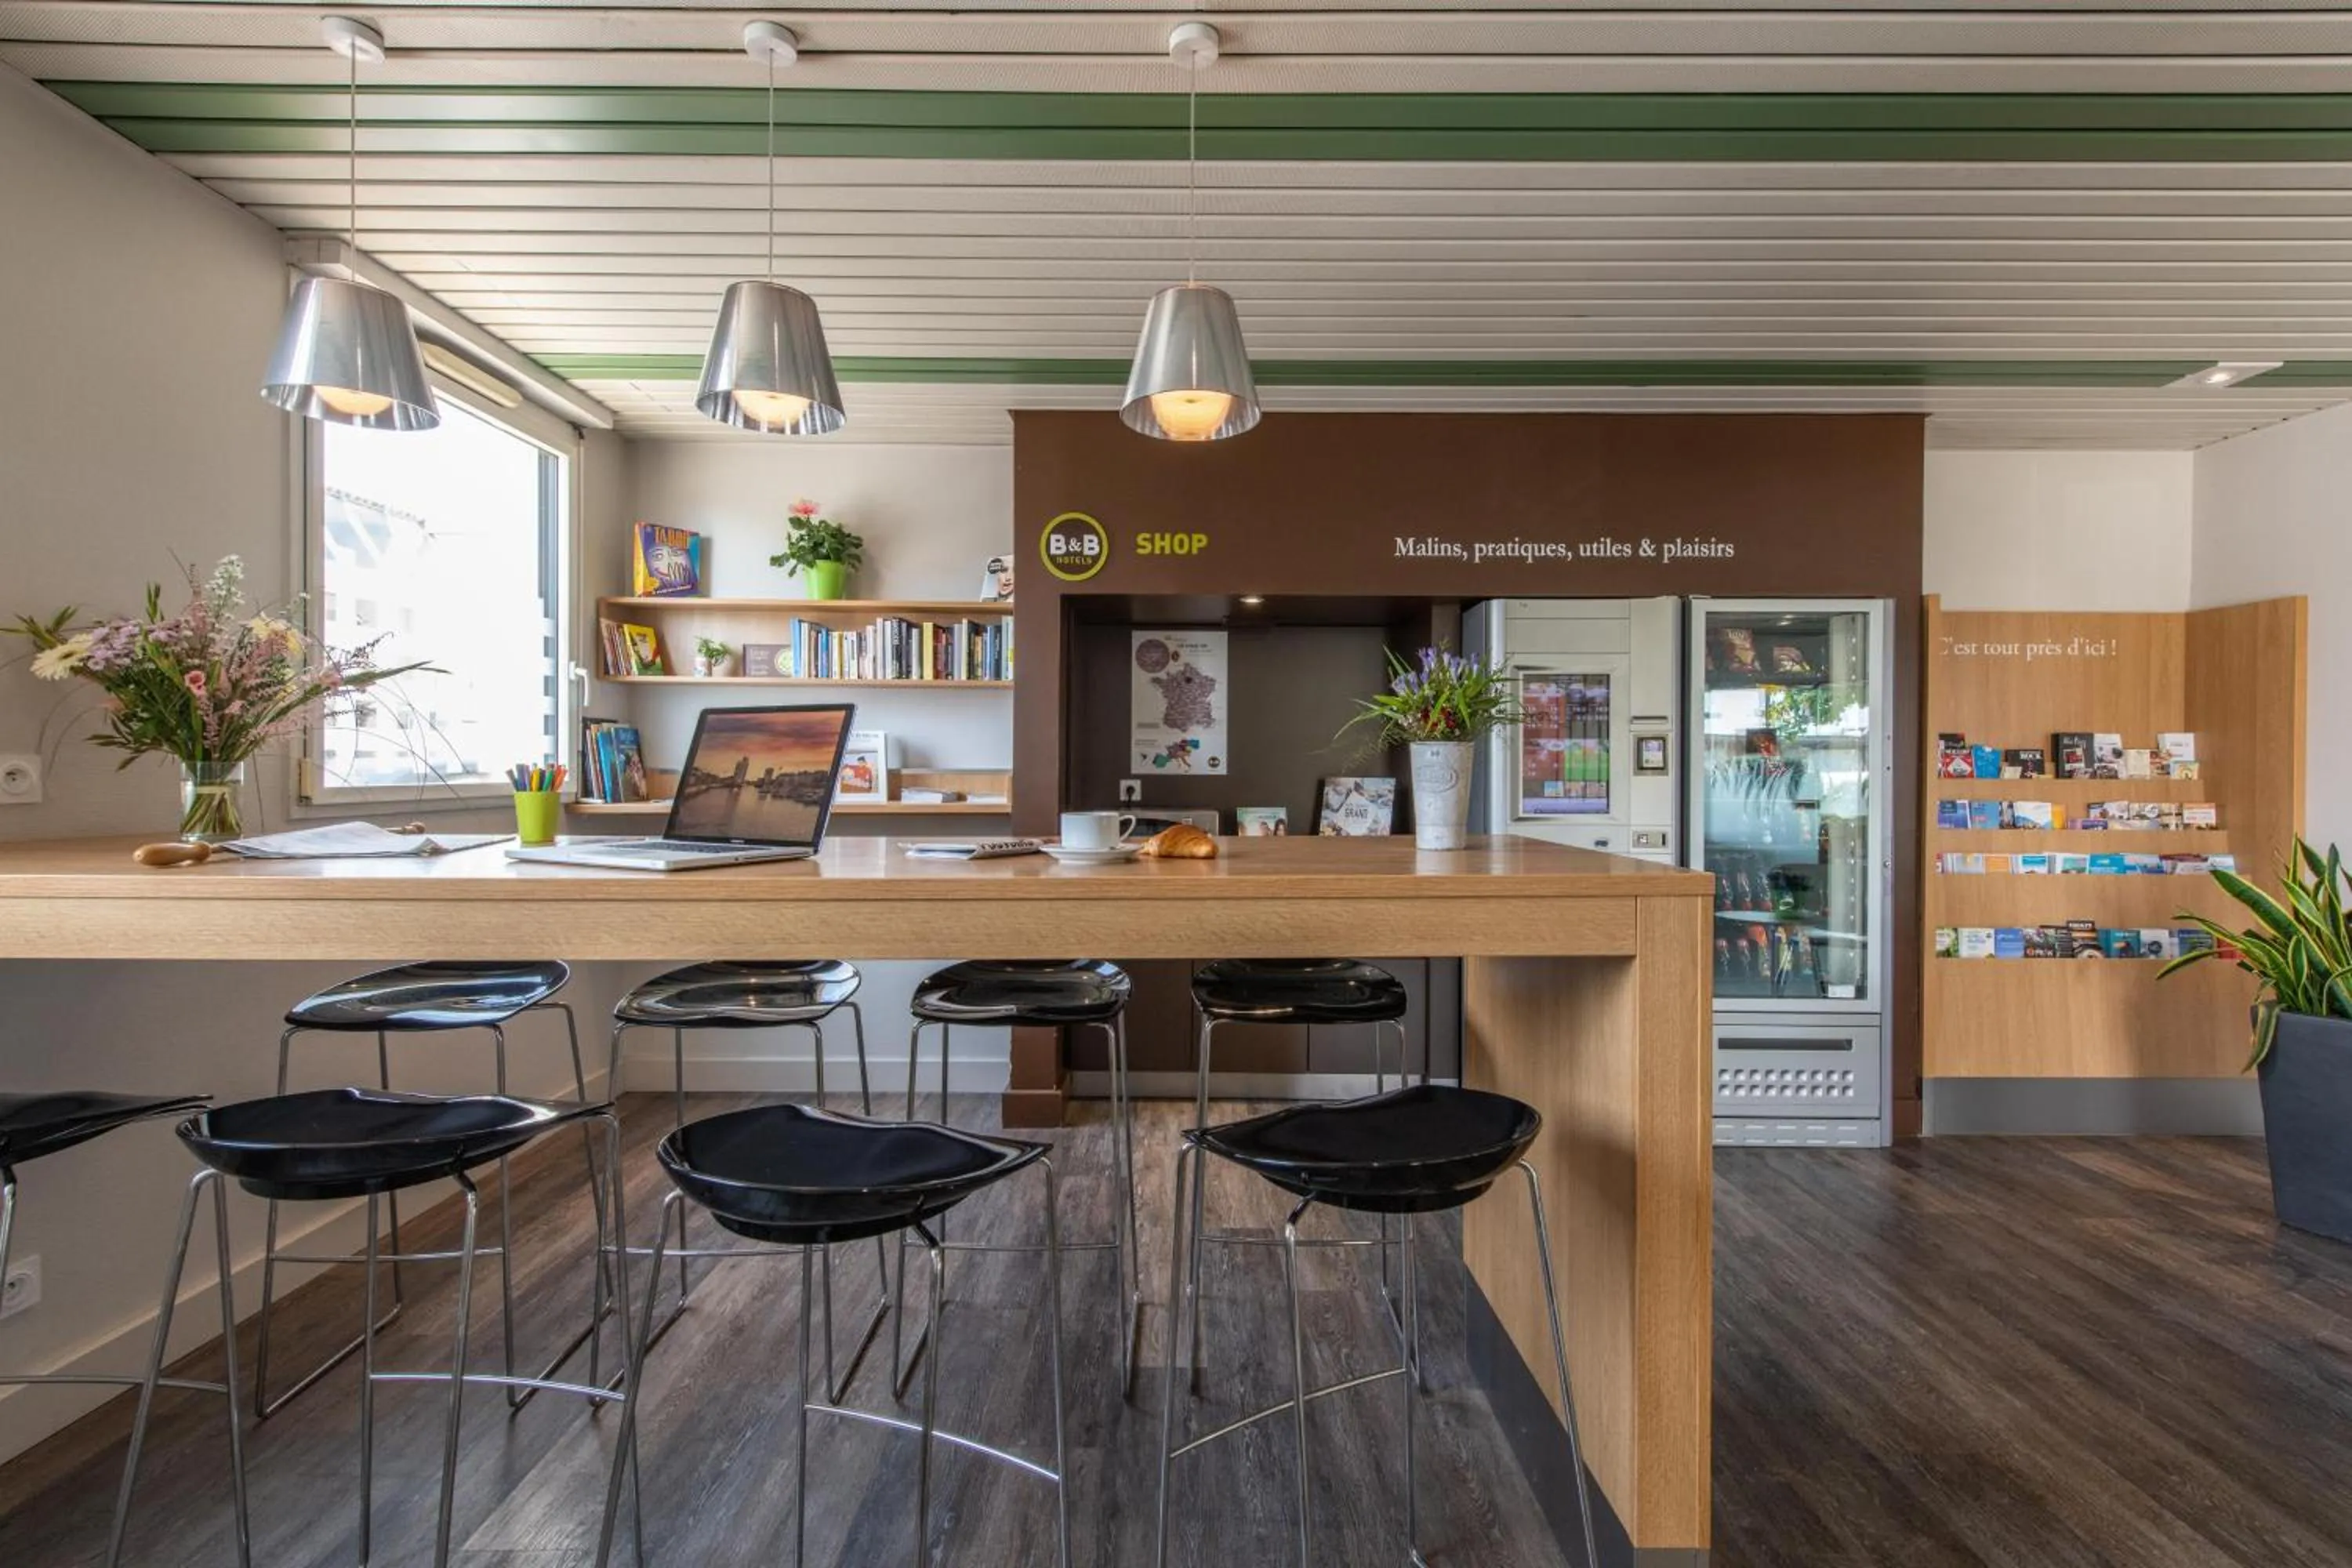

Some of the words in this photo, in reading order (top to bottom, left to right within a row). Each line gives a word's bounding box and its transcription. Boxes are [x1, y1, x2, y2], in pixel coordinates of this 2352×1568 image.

[1050, 534, 1100, 556] B&B
[1136, 532, 1208, 554] SHOP
[1394, 537, 1468, 561] Malins,
[1474, 537, 1572, 563] pratiques,
[1580, 537, 1632, 557] utiles
[1639, 539, 1657, 557] &
[1663, 537, 1735, 563] plaisirs
[1056, 556, 1092, 565] HOTELS
[1984, 641, 2020, 655] tout
[2025, 639, 2063, 661] près
[2067, 637, 2106, 656] d'ici
[2111, 639, 2117, 656] !
